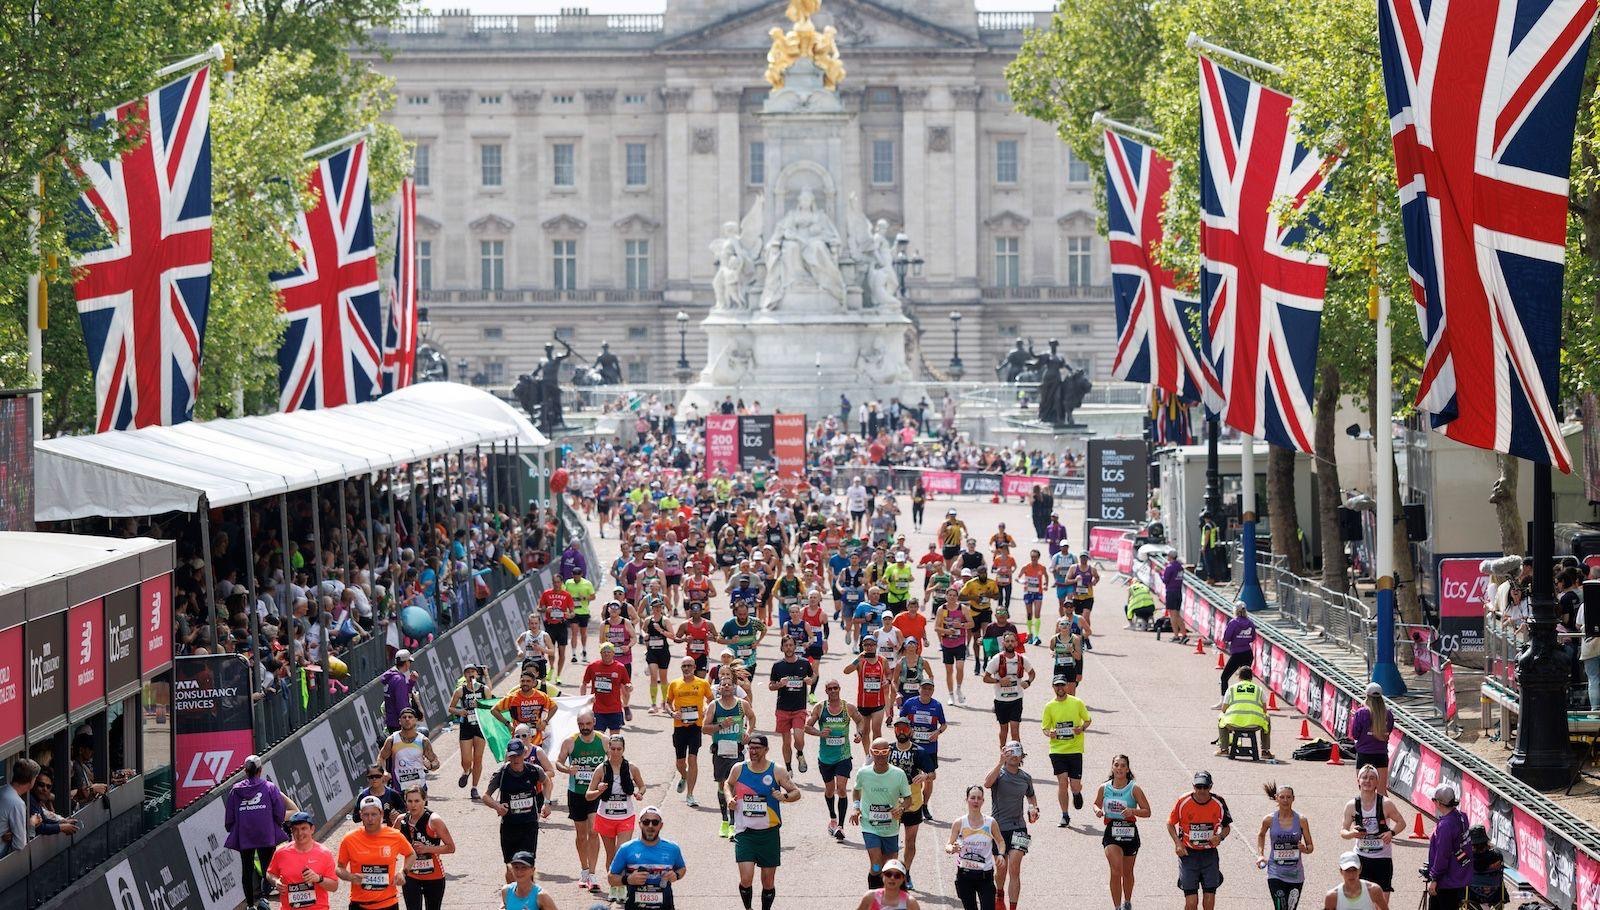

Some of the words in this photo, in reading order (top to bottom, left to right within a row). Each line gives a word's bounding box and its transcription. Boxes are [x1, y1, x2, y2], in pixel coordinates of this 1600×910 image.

[712, 434, 733, 445] 200
[743, 434, 763, 447] tcs
[1102, 467, 1125, 482] tcs
[1102, 504, 1125, 519] tcs
[1443, 577, 1468, 599] tcs
[109, 619, 120, 664] tcs
[30, 648, 43, 698] tcs
[194, 846, 224, 903] tcs
